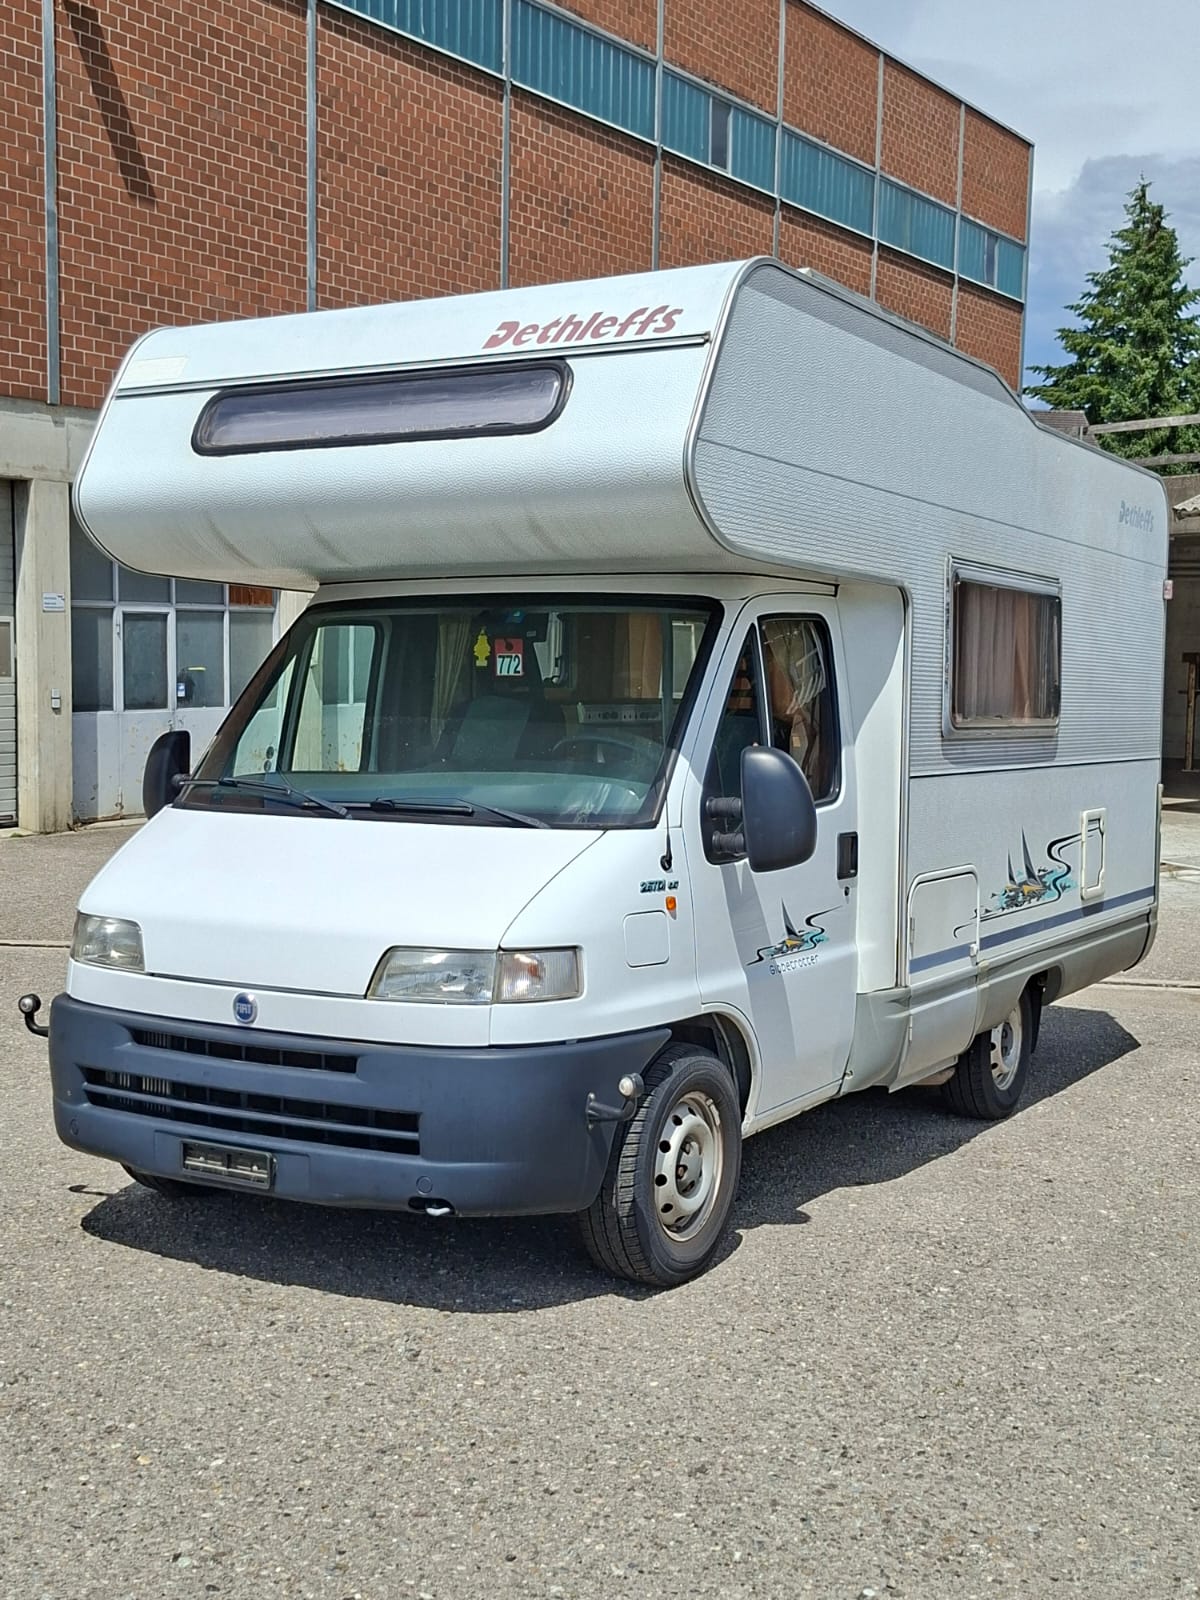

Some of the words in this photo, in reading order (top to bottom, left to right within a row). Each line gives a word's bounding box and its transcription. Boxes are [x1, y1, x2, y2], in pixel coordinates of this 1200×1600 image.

[482, 305, 684, 349] Dethleffs
[498, 654, 521, 674] 772
[236, 1002, 252, 1014] FIAT
